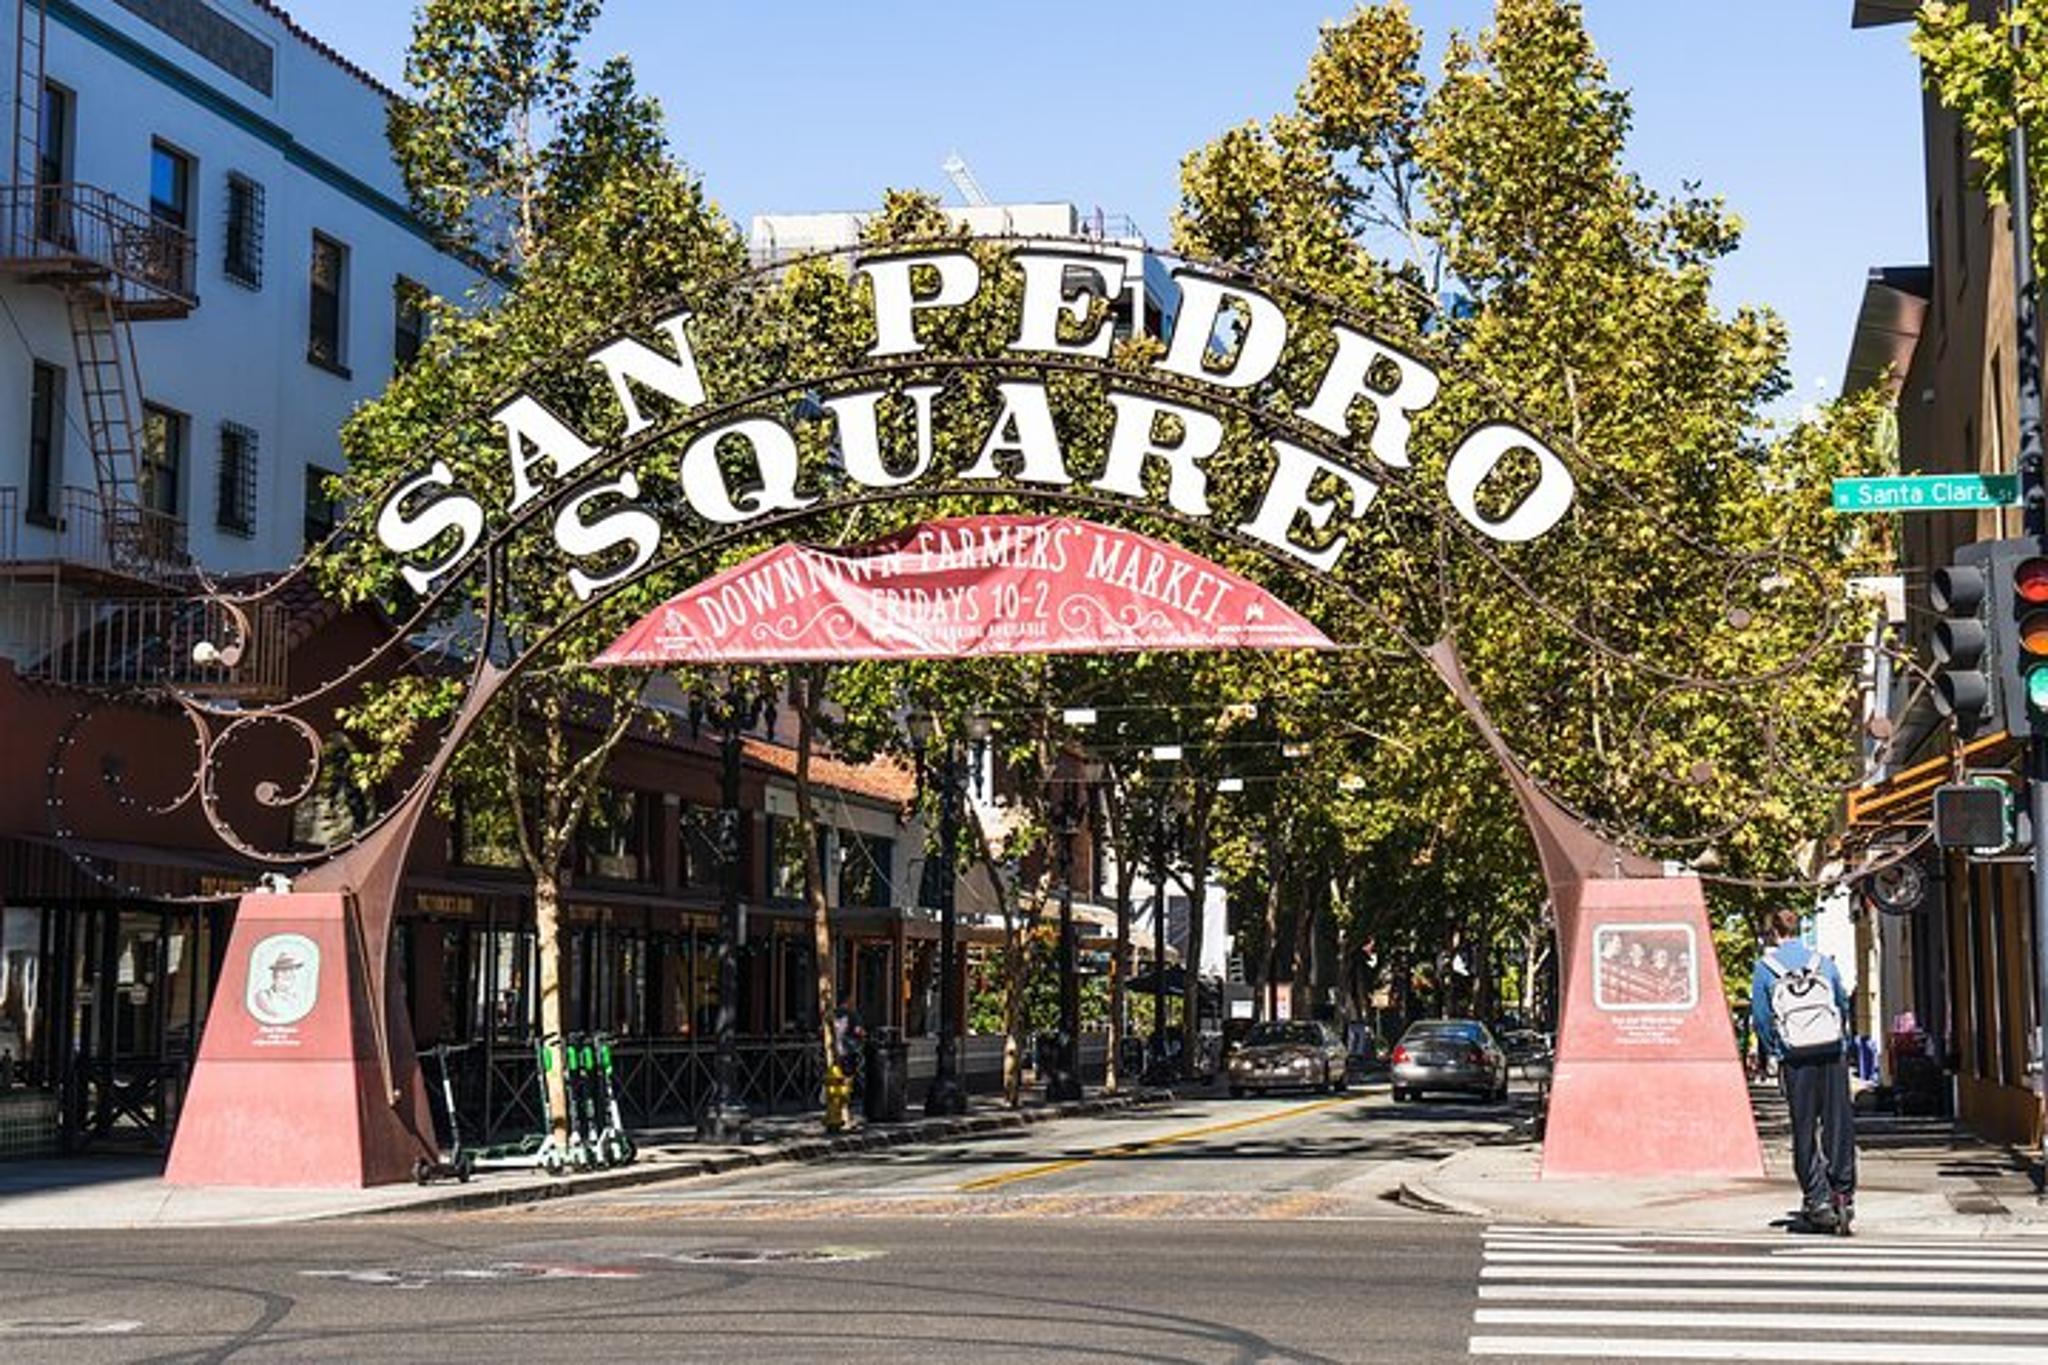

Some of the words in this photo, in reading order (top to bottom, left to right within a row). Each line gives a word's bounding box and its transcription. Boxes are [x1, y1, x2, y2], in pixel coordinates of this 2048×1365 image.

[377, 313, 706, 594] SAN
[859, 252, 1576, 542] PEDRO
[554, 383, 1380, 600] SQUARE
[1858, 483, 1924, 505] Santa
[1931, 481, 1990, 503] Clara
[871, 585, 980, 623] FRIDAYS
[991, 580, 1049, 619] 10-2
[1086, 534, 1235, 623] MARKET
